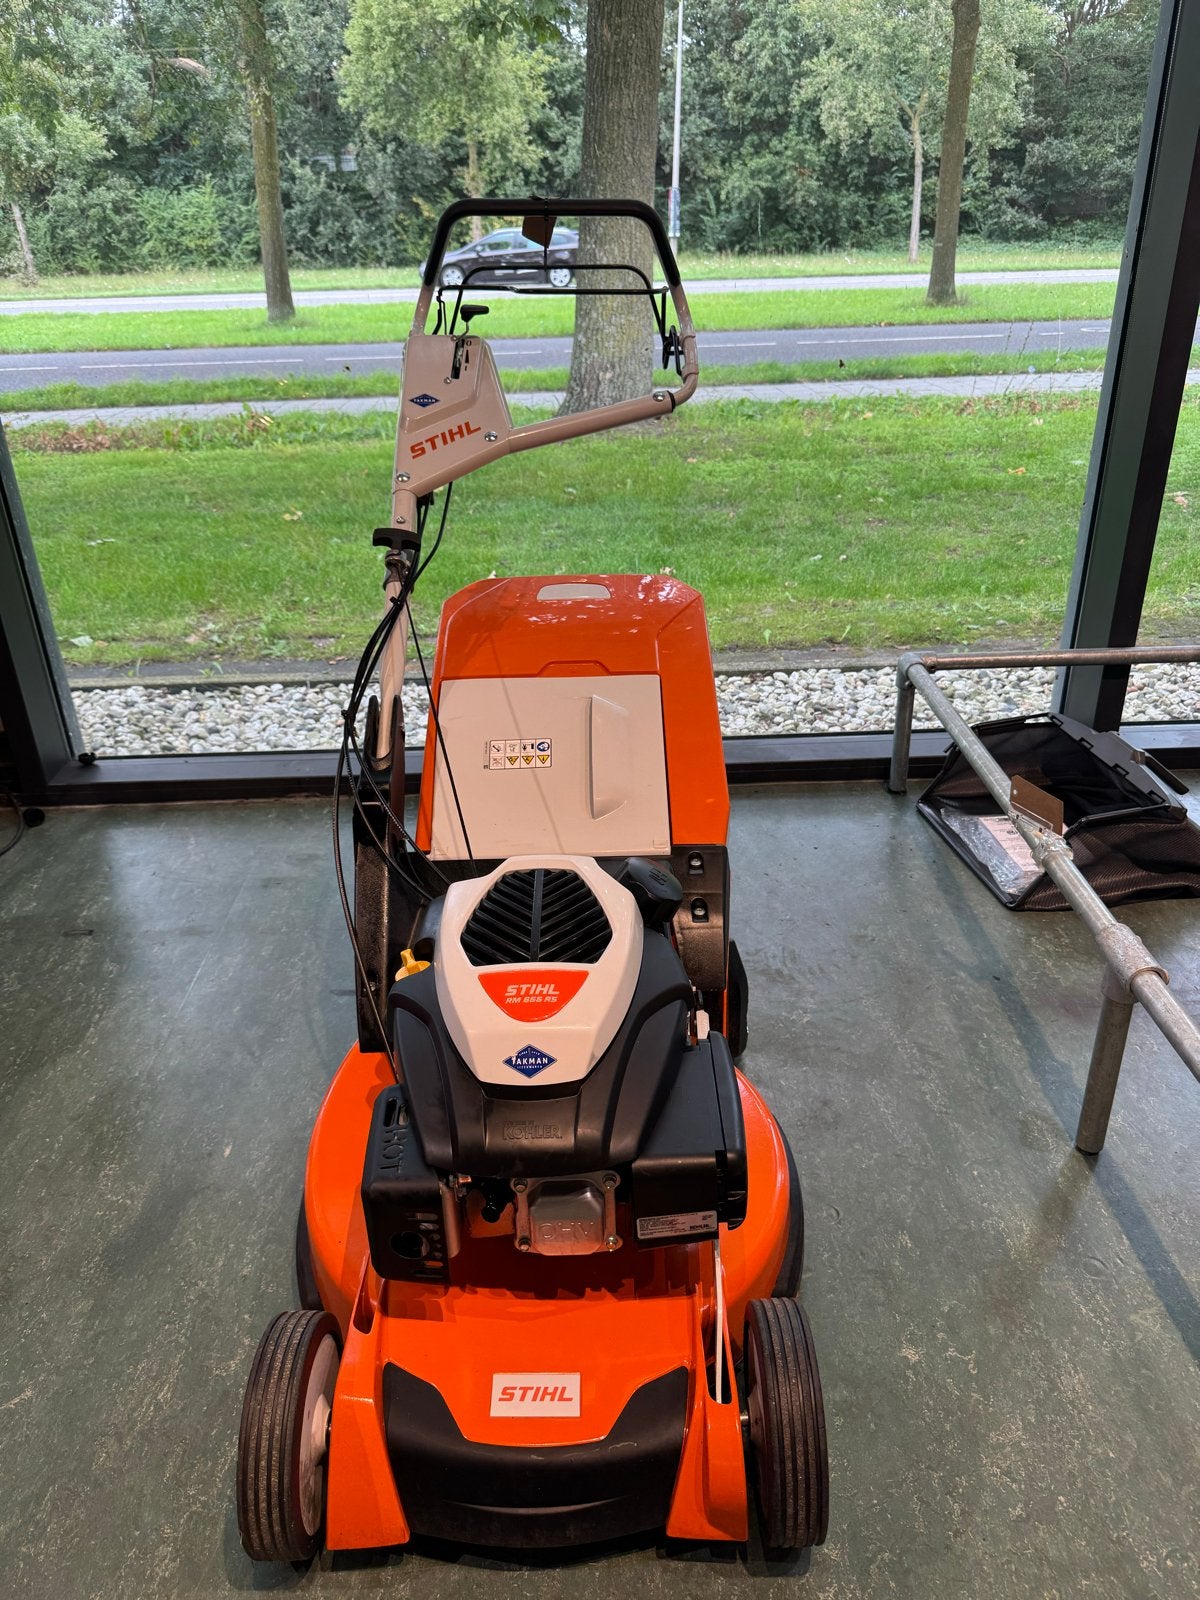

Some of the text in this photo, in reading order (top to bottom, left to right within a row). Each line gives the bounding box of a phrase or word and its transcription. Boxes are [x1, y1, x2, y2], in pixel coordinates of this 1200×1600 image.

[409, 421, 481, 460] STIHL
[504, 983, 560, 996] STIHL
[505, 996, 522, 1004] RM
[544, 995, 558, 1003] RS
[379, 1128, 408, 1174] HOT
[498, 1386, 574, 1402] STIHL
